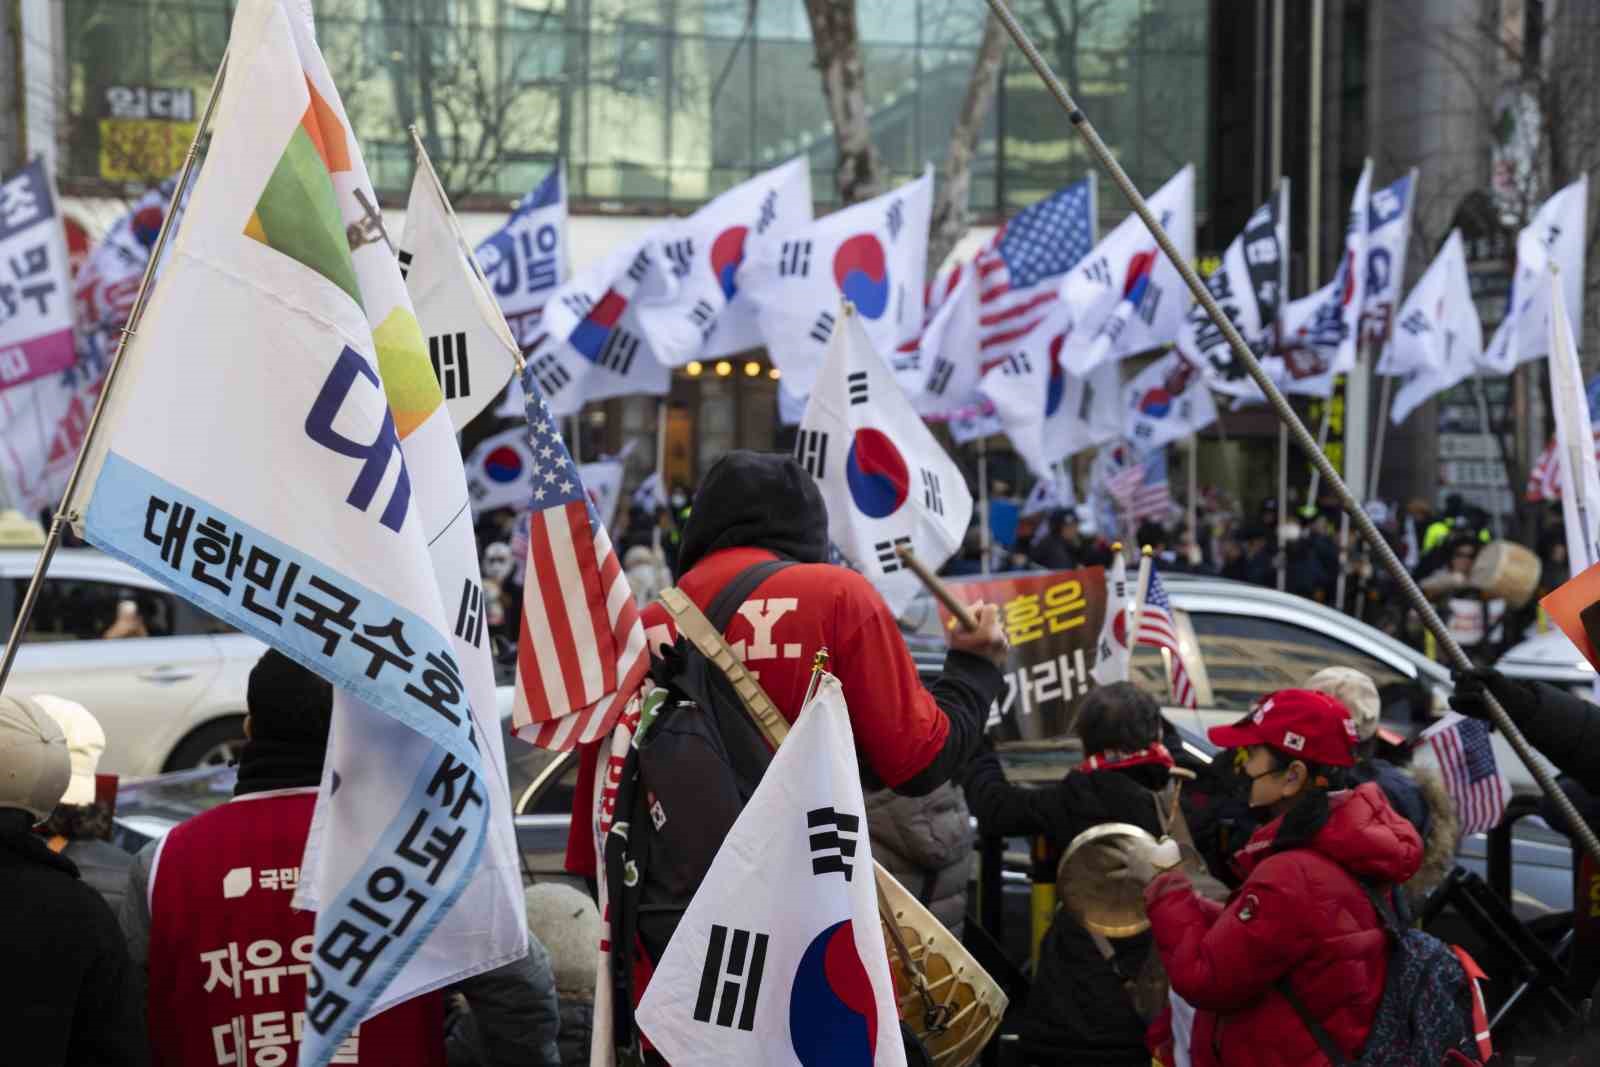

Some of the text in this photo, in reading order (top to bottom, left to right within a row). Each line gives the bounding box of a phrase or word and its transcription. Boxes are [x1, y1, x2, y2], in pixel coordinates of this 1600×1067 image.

[143, 495, 480, 752] 대한민국수호
[1003, 579, 1088, 647] 훈은
[984, 648, 1088, 733] 가라!
[258, 866, 300, 890] 국민
[200, 935, 315, 999] 자유우
[211, 1011, 361, 1067] 대동
